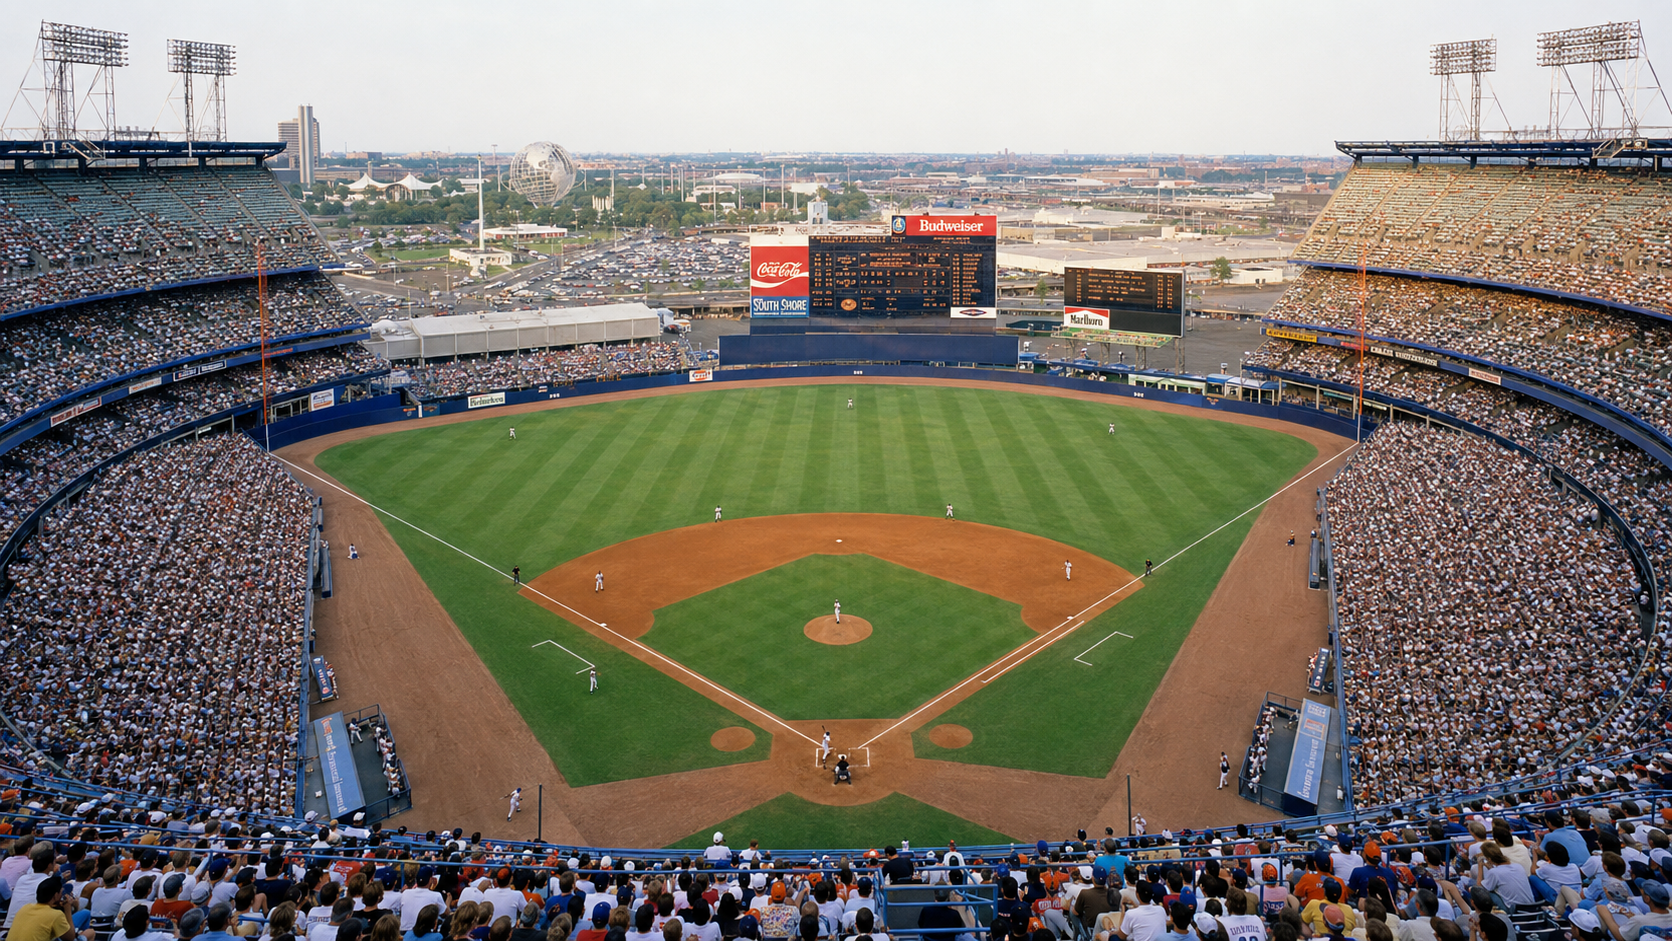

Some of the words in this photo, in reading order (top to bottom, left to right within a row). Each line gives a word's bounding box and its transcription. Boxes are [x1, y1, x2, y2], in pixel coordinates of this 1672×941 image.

[919, 219, 984, 232] Budweiser
[753, 298, 779, 311] SOUTH
[781, 298, 807, 311] SHORE
